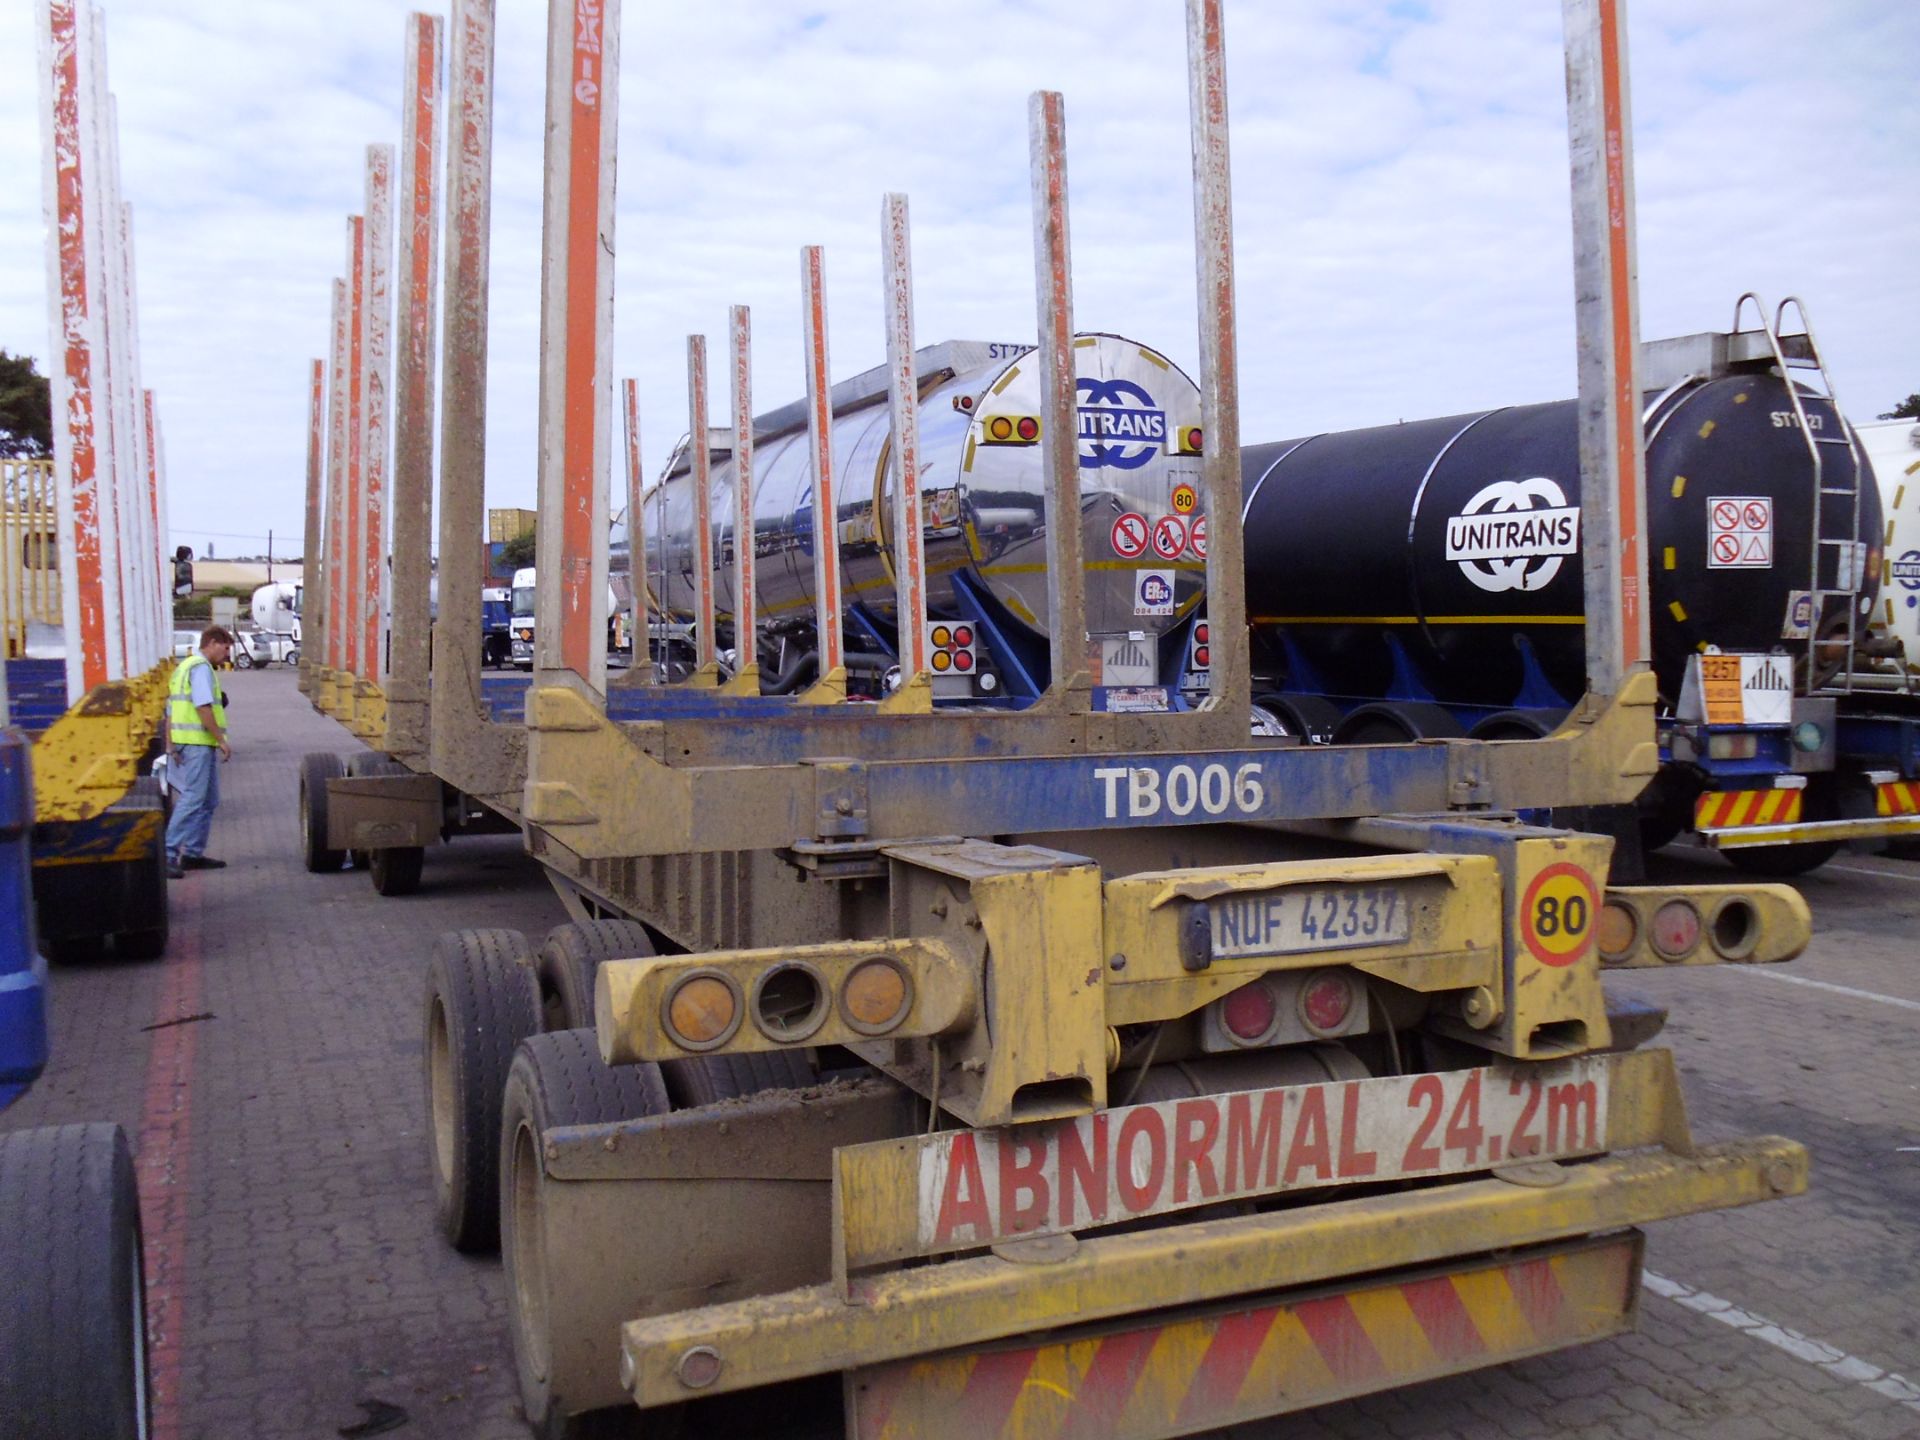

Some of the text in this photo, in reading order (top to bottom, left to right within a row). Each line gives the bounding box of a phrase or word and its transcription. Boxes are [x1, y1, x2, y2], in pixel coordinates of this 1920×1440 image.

[1076, 410, 1164, 438] ITRANS
[1770, 411, 1823, 430] ST127
[1175, 495, 1193, 507] 80
[1451, 517, 1572, 552] UNITRANS
[1094, 763, 1265, 819] TB006
[1219, 888, 1398, 948] NUF 42337
[1535, 895, 1587, 938] 80
[932, 1066, 1600, 1245] ABNORMAL 24.2m
